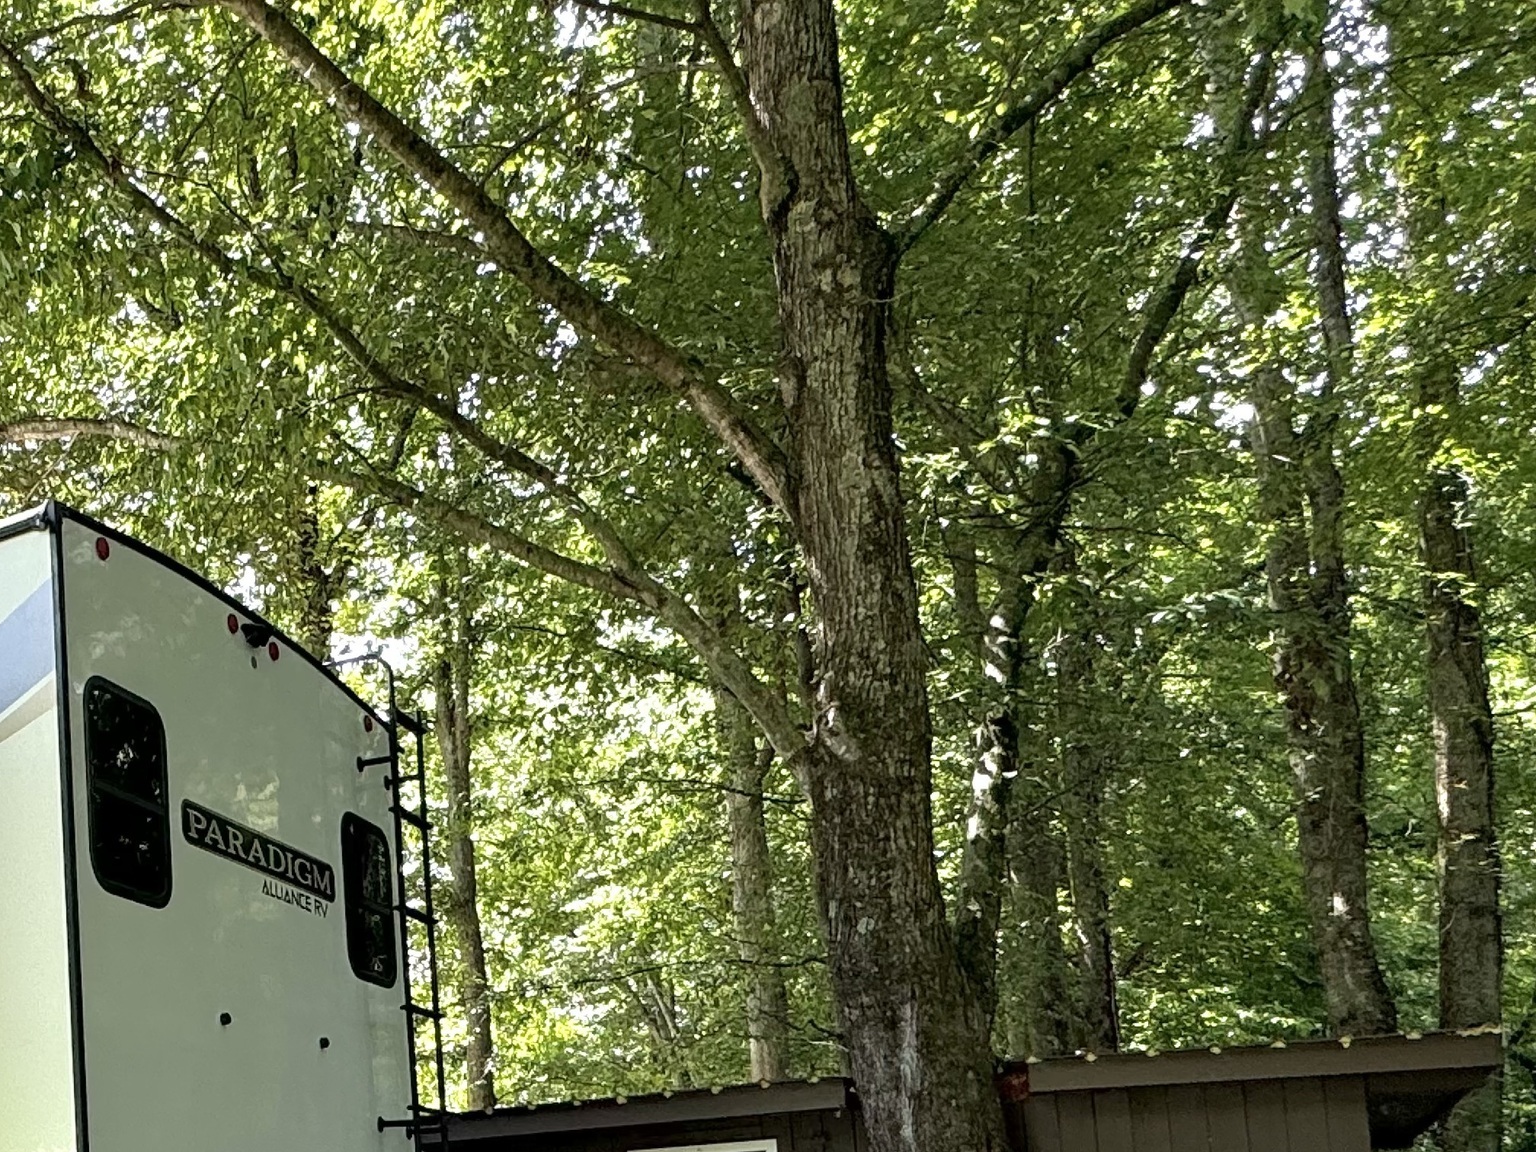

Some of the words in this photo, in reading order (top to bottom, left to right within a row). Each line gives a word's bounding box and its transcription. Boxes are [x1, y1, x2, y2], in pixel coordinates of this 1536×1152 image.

[186, 807, 332, 895] PARADIGM
[262, 879, 312, 912] ALLIANCE
[314, 898, 328, 918] RV
